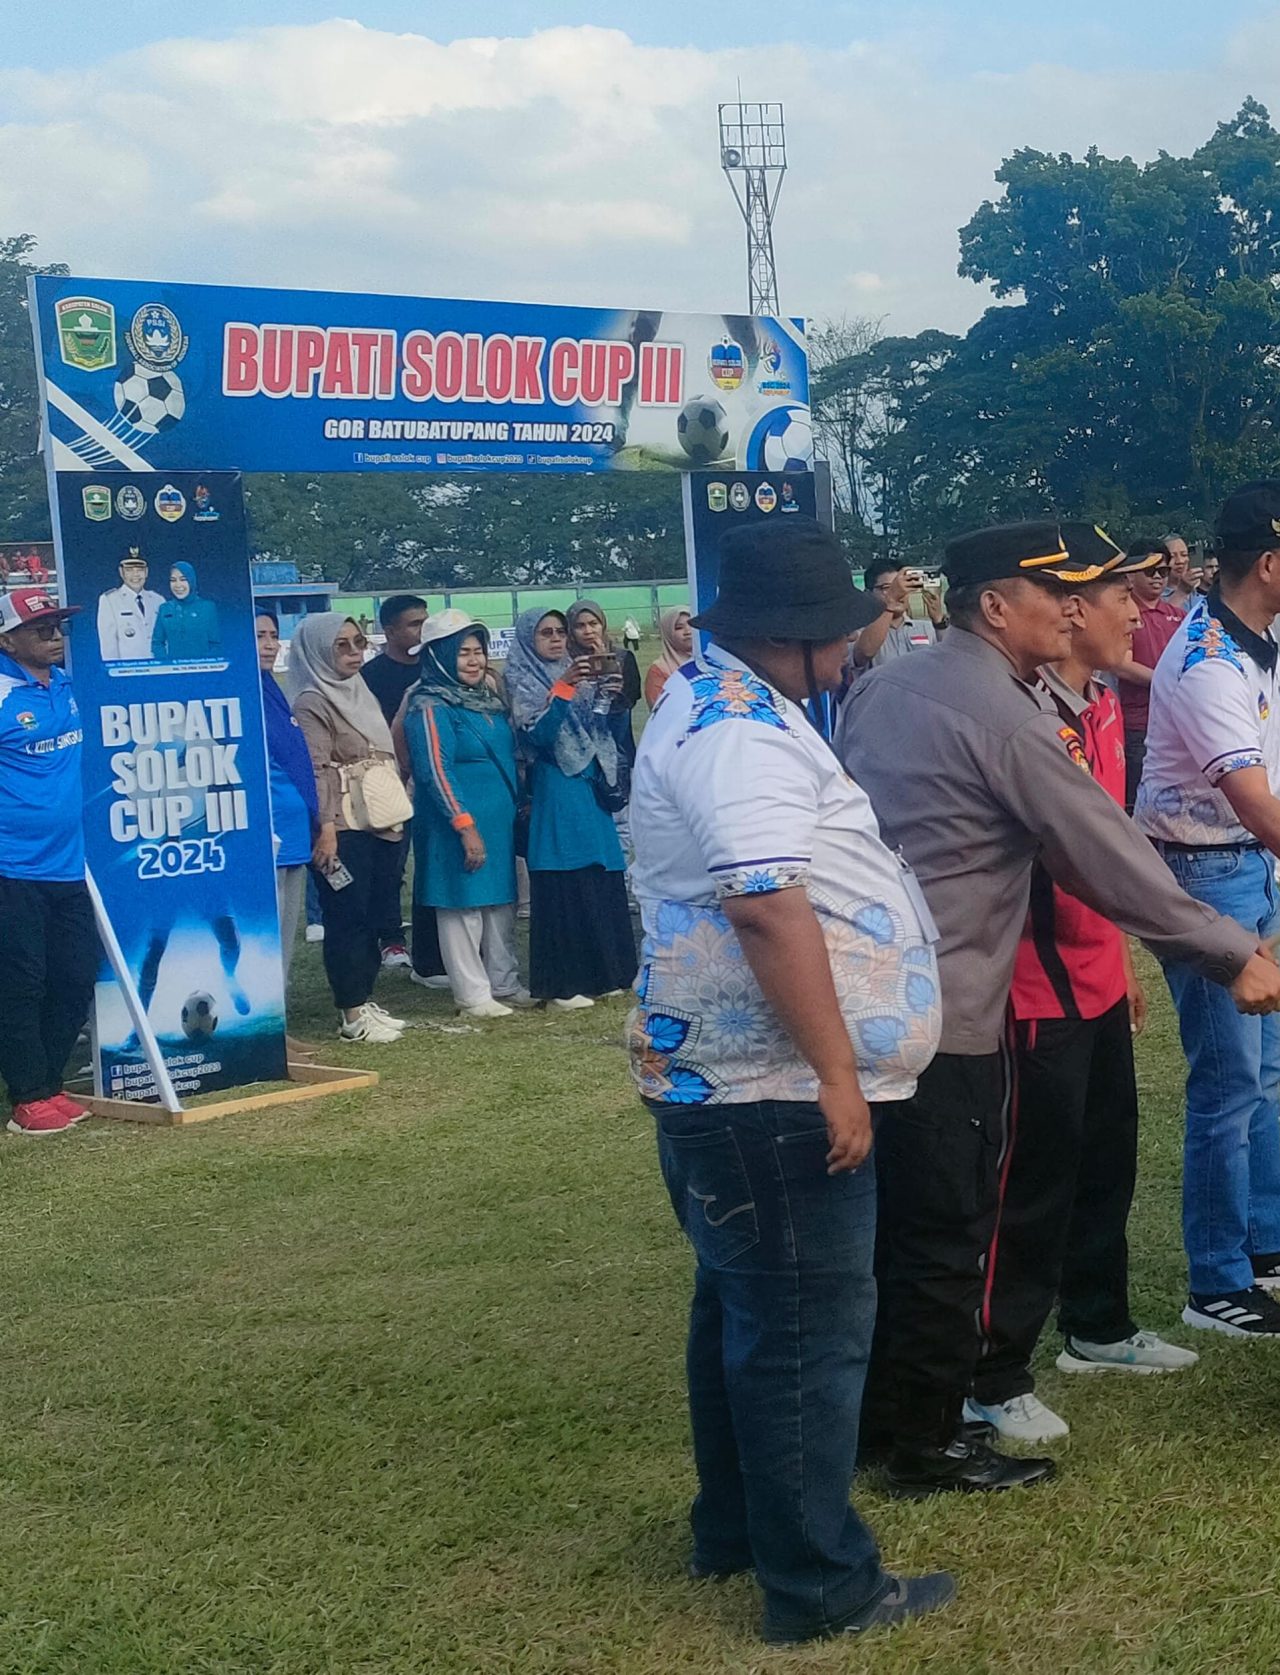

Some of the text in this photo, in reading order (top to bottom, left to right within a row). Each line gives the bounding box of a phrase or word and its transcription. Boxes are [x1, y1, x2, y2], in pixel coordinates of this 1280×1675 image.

[224, 323, 684, 406] BUPATI SOLOK CUP III
[324, 419, 614, 442] GOR BATUBATUPANG TAHUN 2024
[100, 697, 243, 747] BUPATI
[110, 744, 243, 795] SOLOK
[110, 790, 249, 842] CUP III
[138, 839, 225, 879] 2024
[185, 1054, 204, 1064] cup
